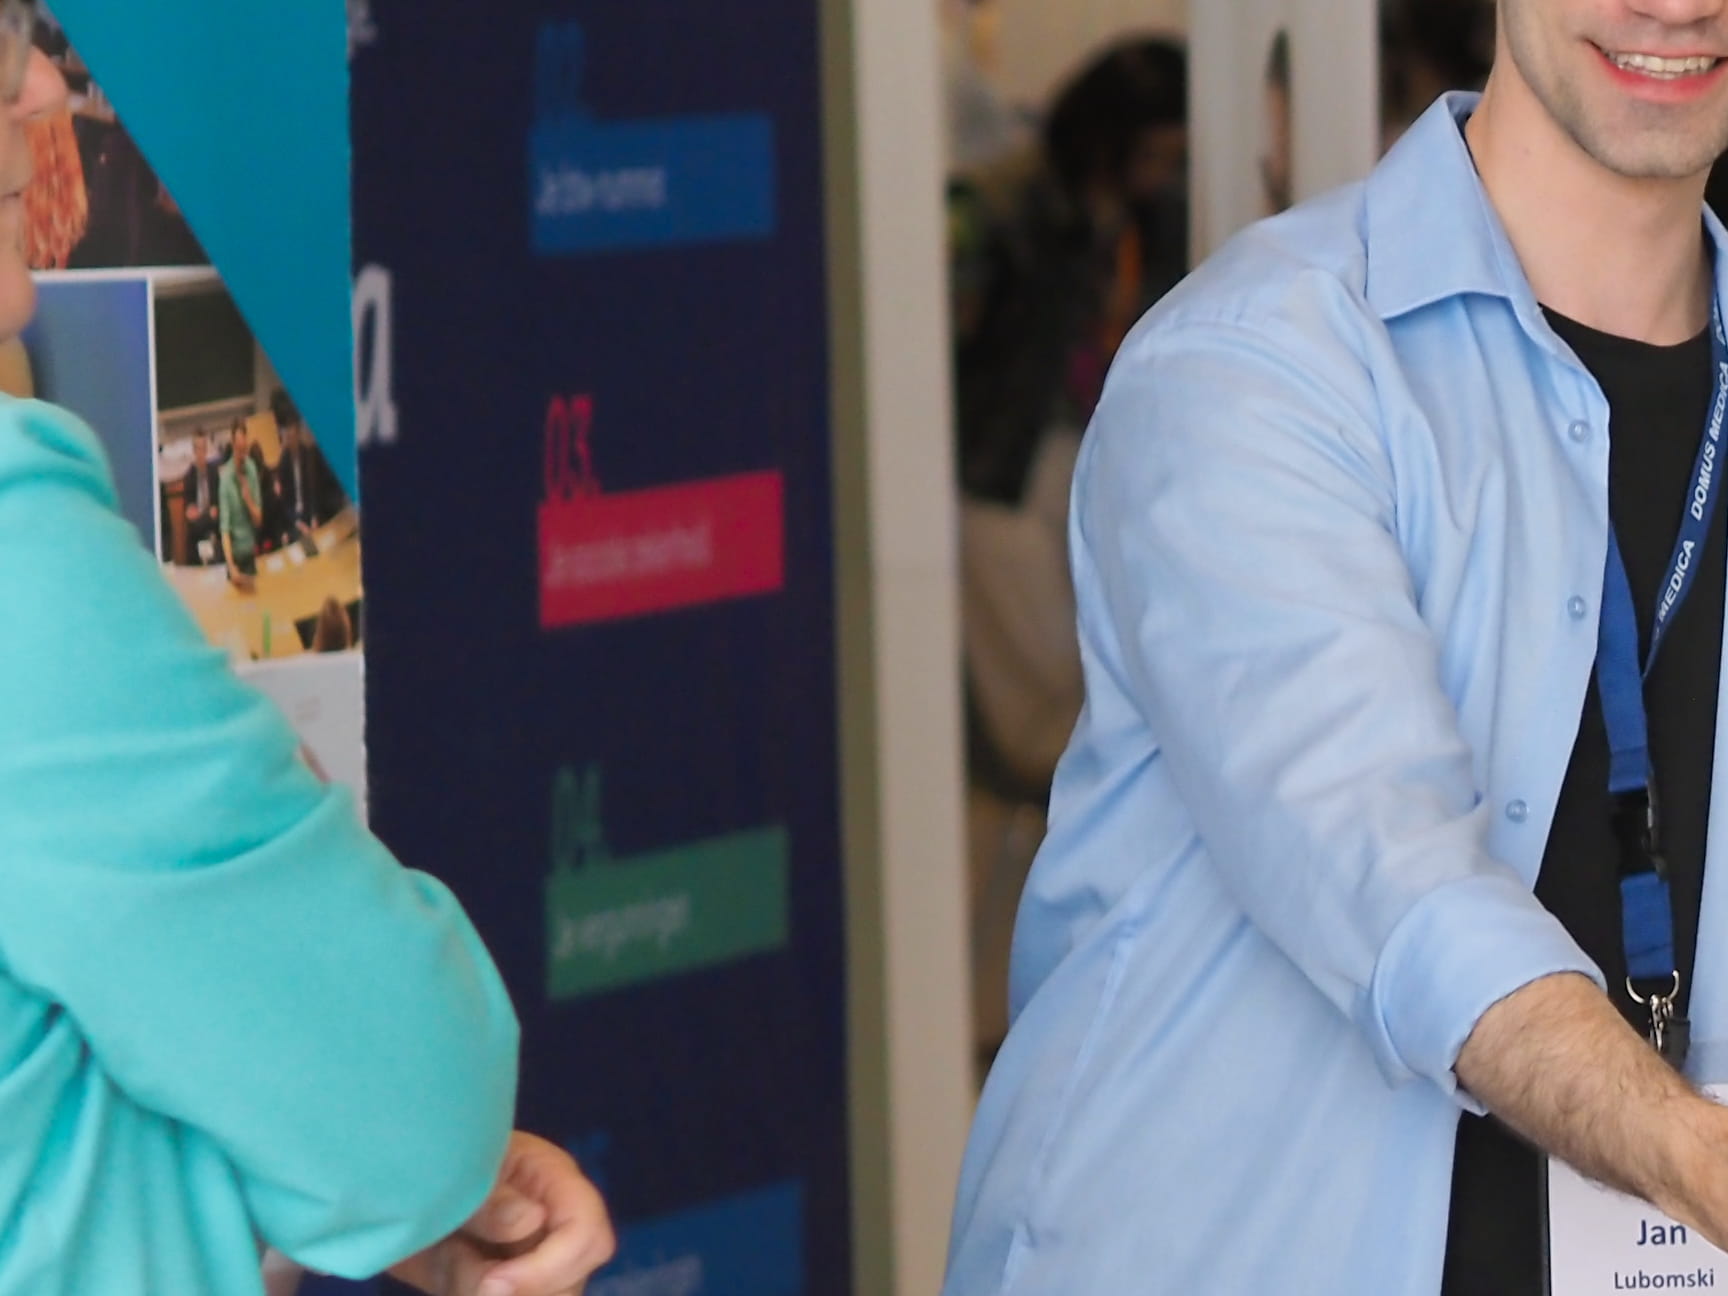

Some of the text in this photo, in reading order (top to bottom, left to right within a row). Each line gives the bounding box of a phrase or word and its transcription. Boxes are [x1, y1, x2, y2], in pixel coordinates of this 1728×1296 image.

[1690, 444, 1716, 521] DOMUS
[1657, 540, 1696, 625] MEDICA
[1636, 1219, 1687, 1246] Jan
[1614, 1268, 1715, 1290] Lubomski
